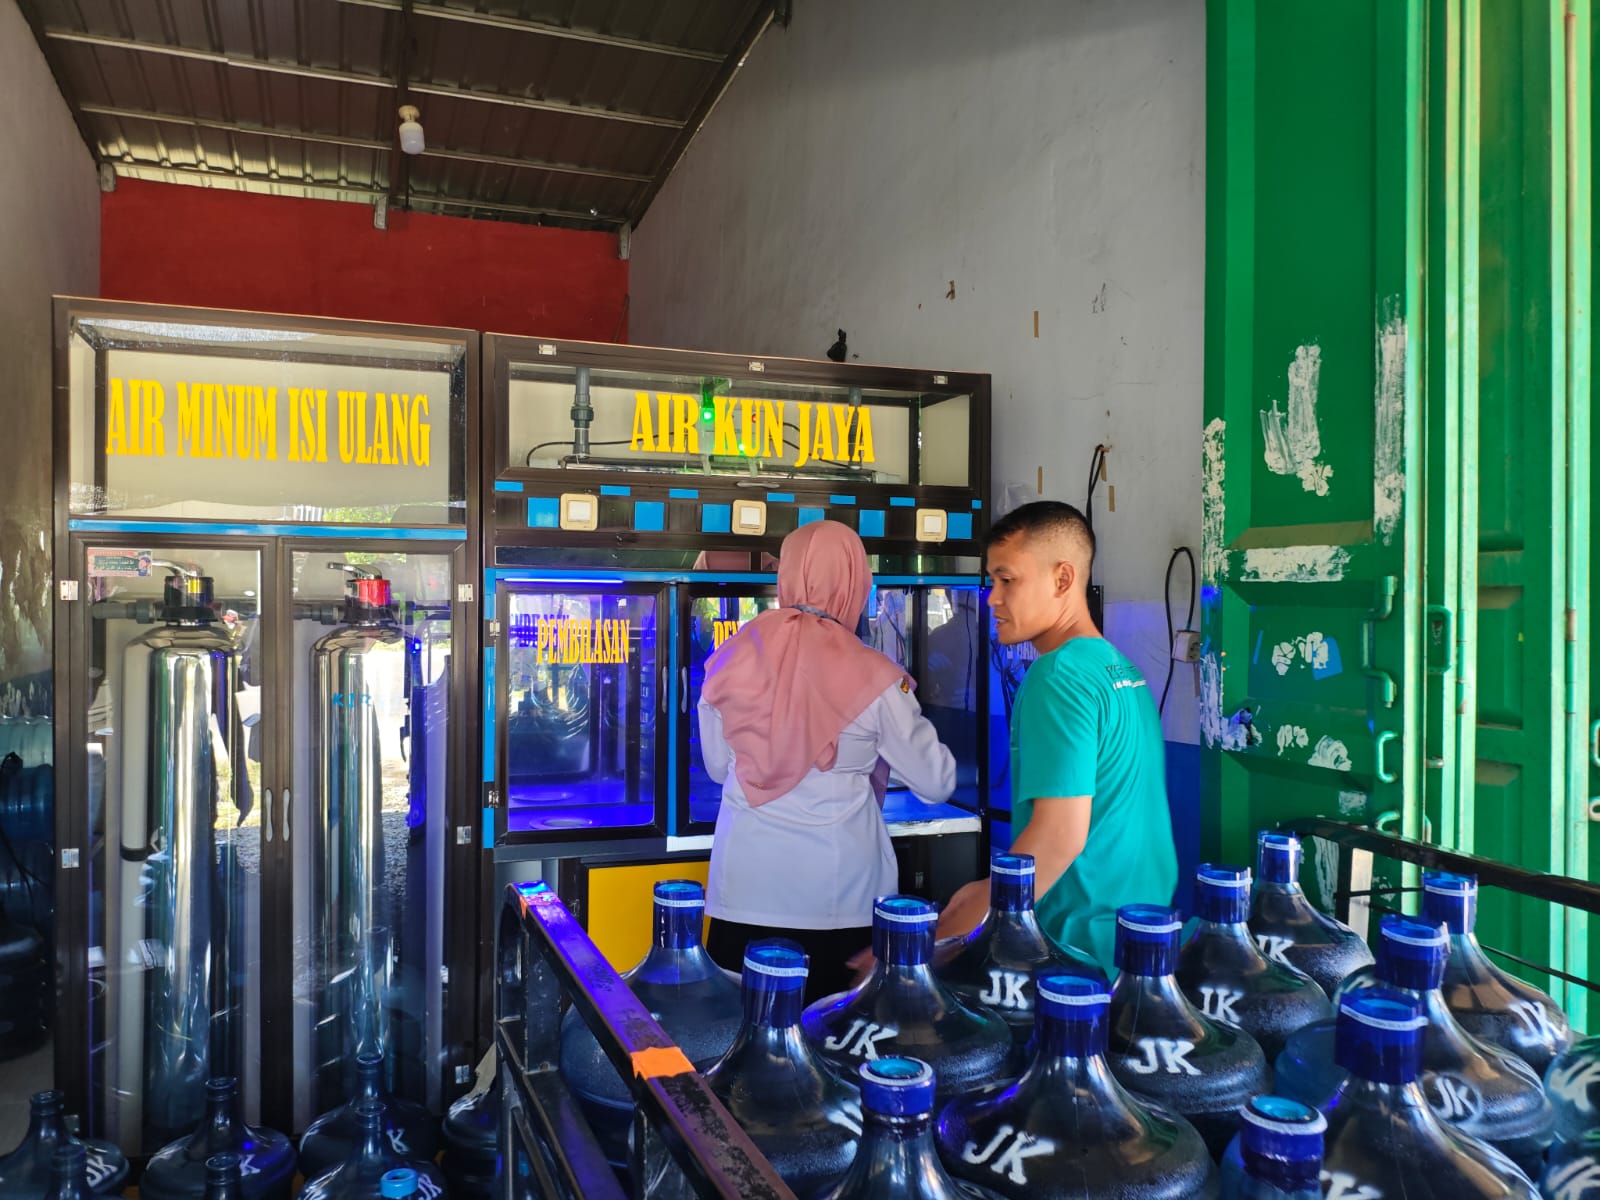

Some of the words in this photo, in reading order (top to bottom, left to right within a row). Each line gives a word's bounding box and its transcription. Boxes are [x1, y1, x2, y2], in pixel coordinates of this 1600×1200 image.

[106, 378, 165, 456] AIR
[176, 382, 278, 460] MINUM
[287, 387, 328, 463] ISI
[337, 391, 431, 467] ULANG
[630, 392, 700, 454] AIR
[712, 396, 785, 458] KUN
[794, 403, 876, 467] JAYA
[536, 618, 631, 664] PEMBILASAN
[979, 969, 1030, 1010] JK
[824, 1020, 898, 1060] JK
[1125, 1039, 1202, 1075] JK
[386, 1128, 409, 1153] K
[963, 1125, 1055, 1185] JK
[86, 1155, 117, 1187] JK
